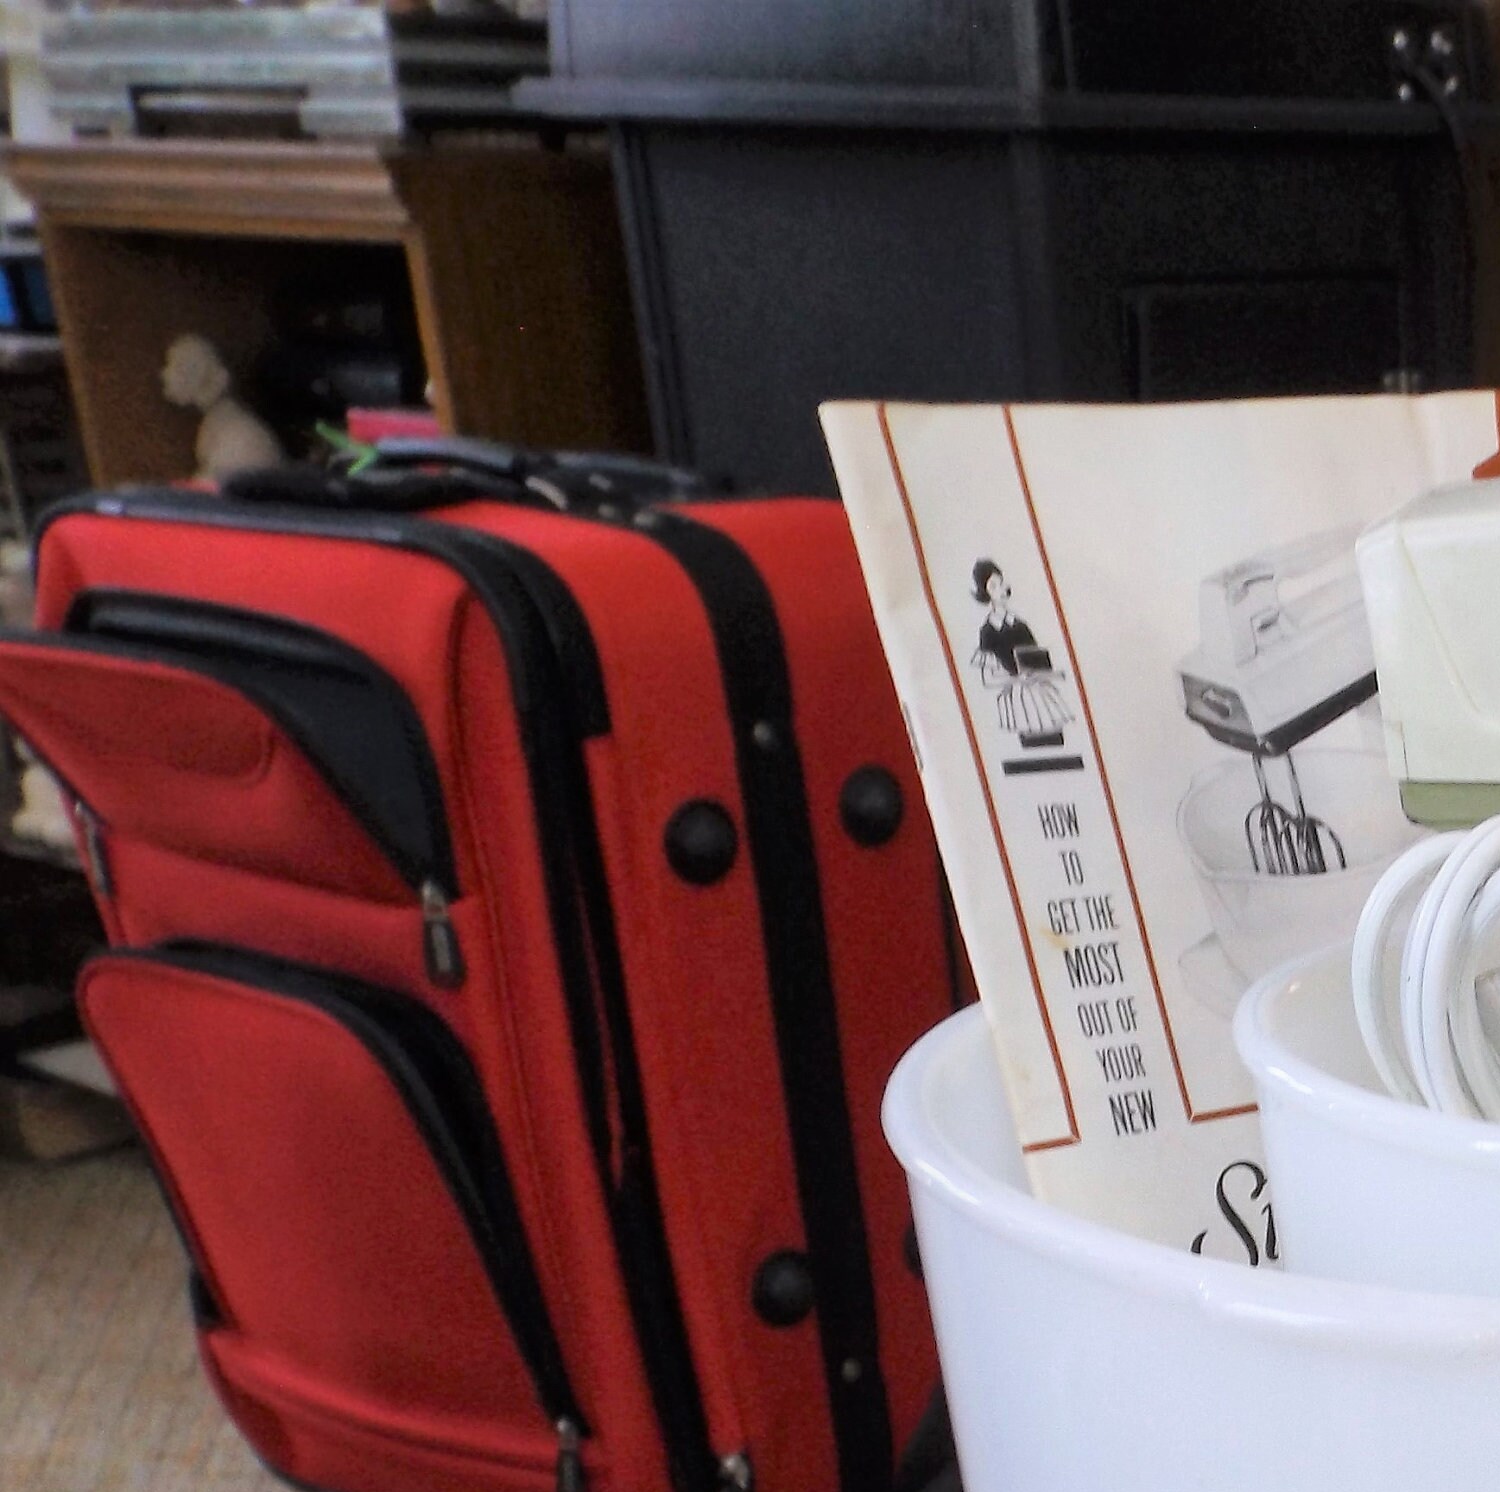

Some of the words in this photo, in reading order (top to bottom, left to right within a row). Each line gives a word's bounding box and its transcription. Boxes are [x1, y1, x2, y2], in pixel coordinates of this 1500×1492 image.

[1038, 803, 1079, 840] HOW
[1059, 850, 1084, 885] TO
[1047, 897, 1079, 935] GET
[1081, 894, 1119, 931] THE
[1063, 943, 1125, 989] MOST
[1077, 999, 1113, 1038] OUT
[1115, 996, 1138, 1031] OF
[1096, 1043, 1146, 1083] YOUR
[1108, 1090, 1156, 1137] NEW
